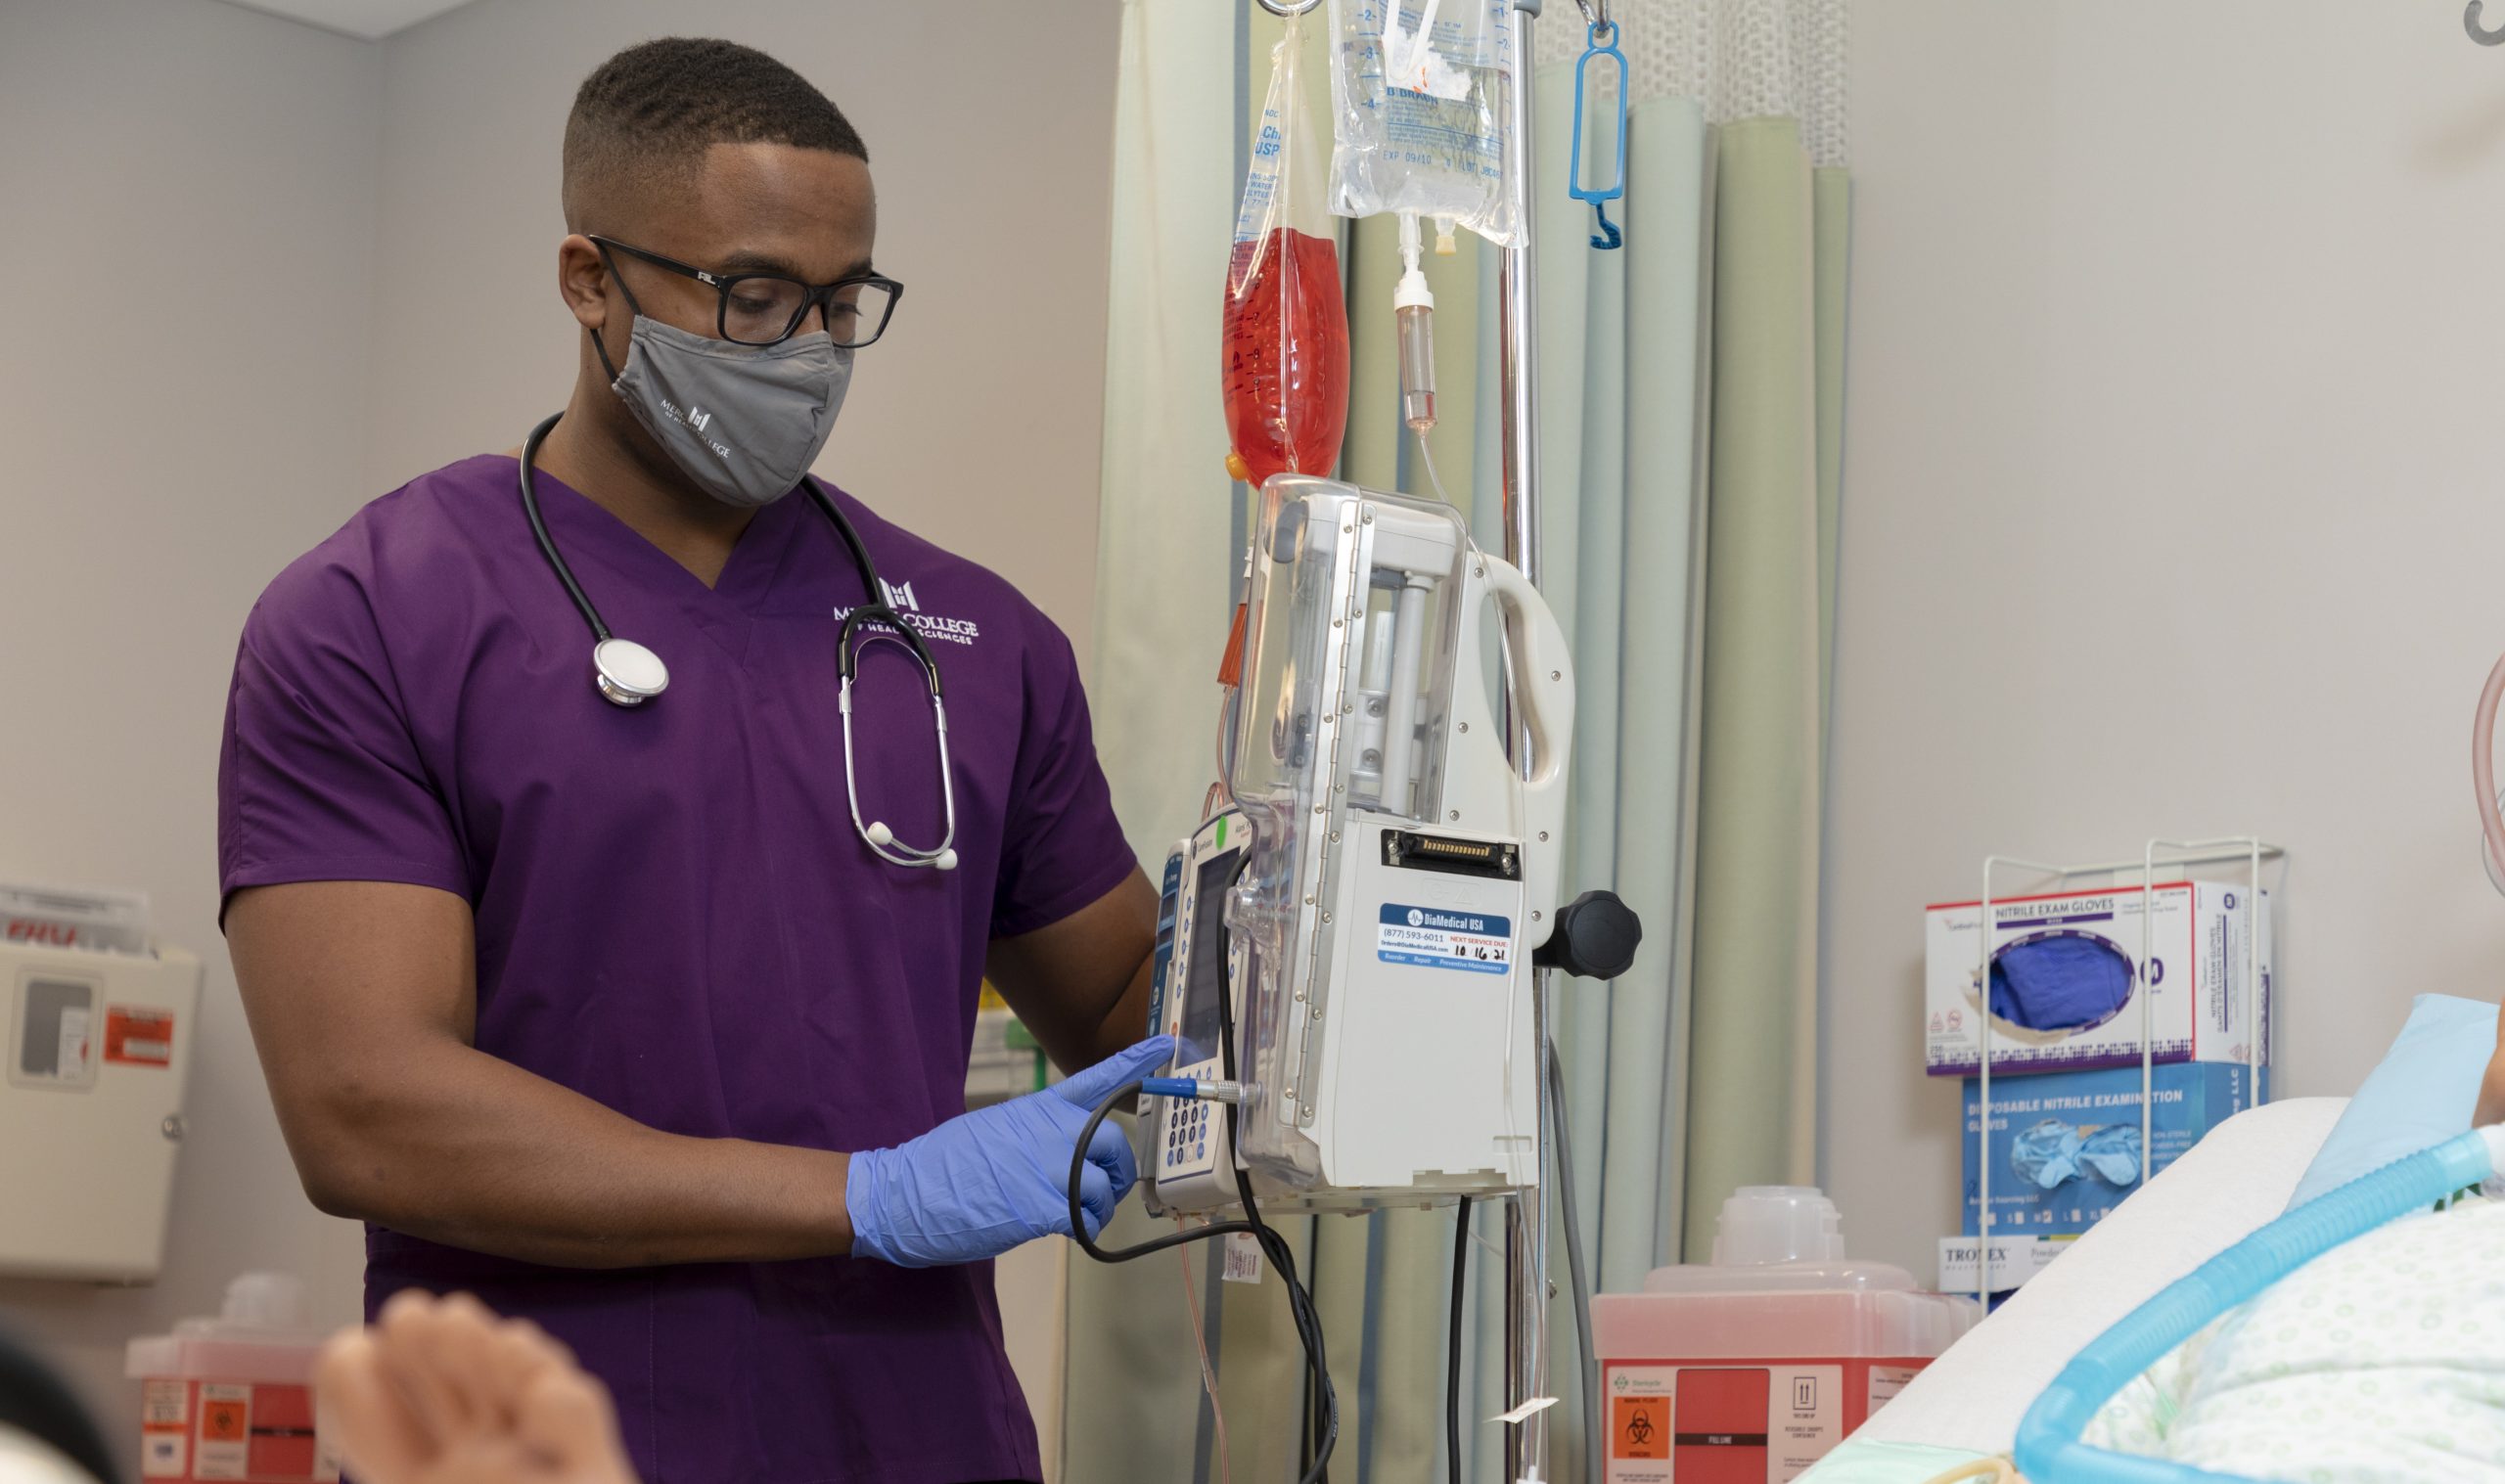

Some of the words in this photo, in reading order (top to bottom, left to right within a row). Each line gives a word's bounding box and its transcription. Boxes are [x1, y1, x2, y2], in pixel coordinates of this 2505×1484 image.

[1387, 86, 1394, 97] B
[1255, 141, 1280, 157] USP
[1383, 151, 1398, 161] EXP
[1405, 152, 1432, 165] 09/10
[660, 398, 687, 422] MERC
[902, 613, 979, 637] COLLEGE
[868, 623, 900, 635] HEAL
[917, 629, 974, 646] SCIENCES
[1996, 902, 2035, 919] NITRILE
[2038, 899, 2070, 915] EXAM
[2072, 897, 2115, 914] GLOVES
[1424, 913, 1468, 929] DiaMedical
[1469, 919, 1483, 931] USA
[1384, 928, 1404, 939] (877)
[1406, 930, 1443, 943] 593-6011
[1469, 937, 1493, 947] SERVICE
[1968, 1098, 2040, 1116] DIPOSABLE
[2043, 1095, 2092, 1111] NITRILE
[2094, 1090, 2183, 1107] EXAMINTION
[1968, 1120, 2008, 1134] GLVES
